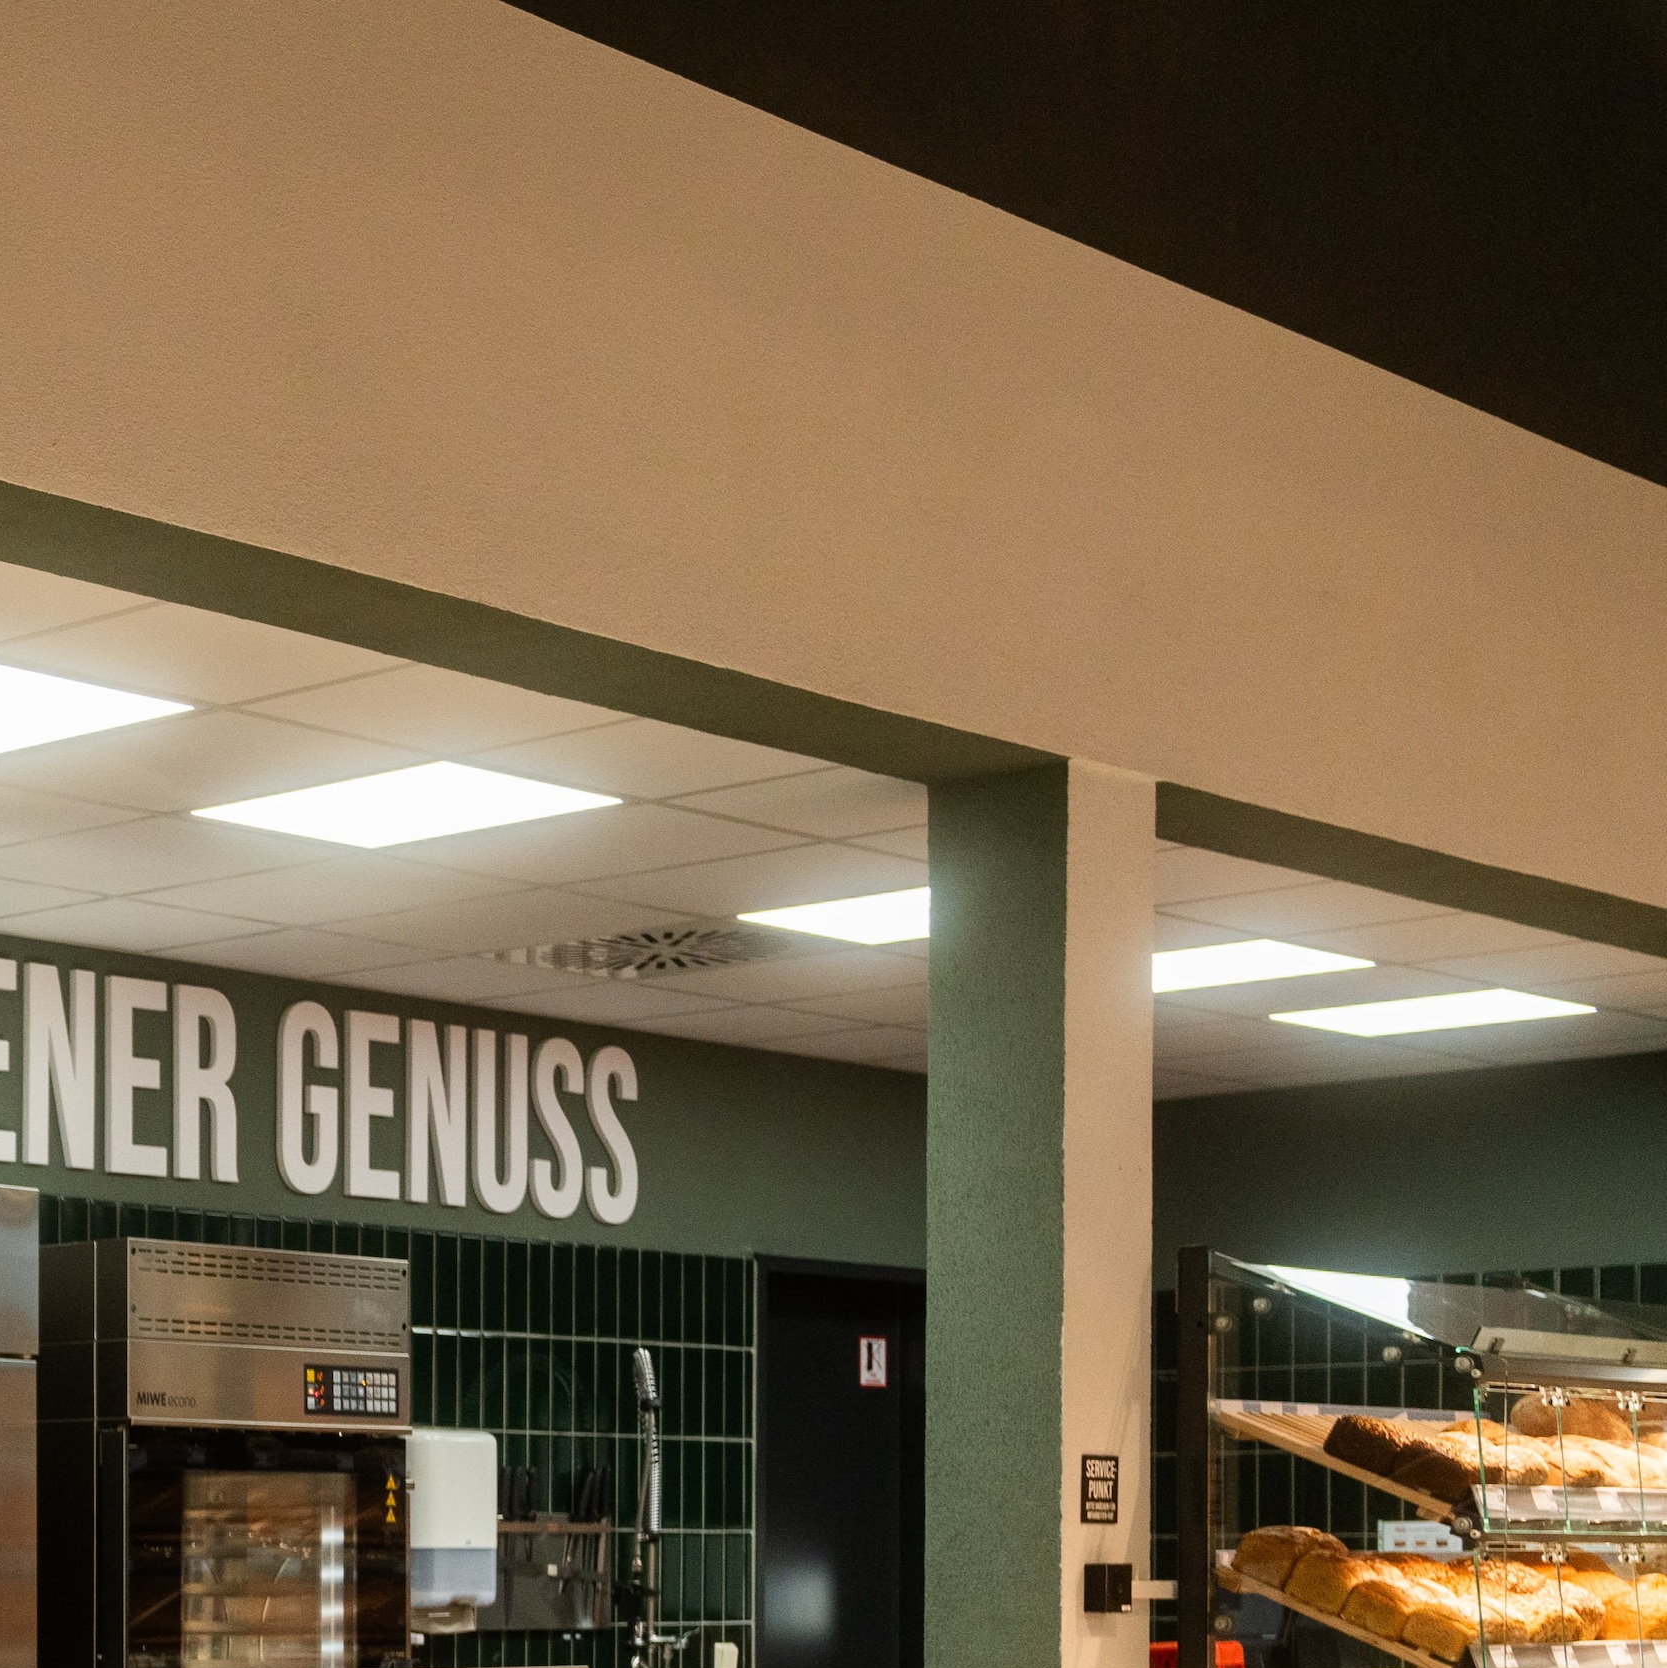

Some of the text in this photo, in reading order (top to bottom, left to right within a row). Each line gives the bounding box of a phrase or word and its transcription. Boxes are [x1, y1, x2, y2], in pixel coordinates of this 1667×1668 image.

[275, 999, 640, 1227] GENUSS
[137, 1391, 197, 1408] MIWE econo
[1086, 1459, 1117, 1479] SERVICE-
[1088, 1479, 1114, 1500] PUNKT
